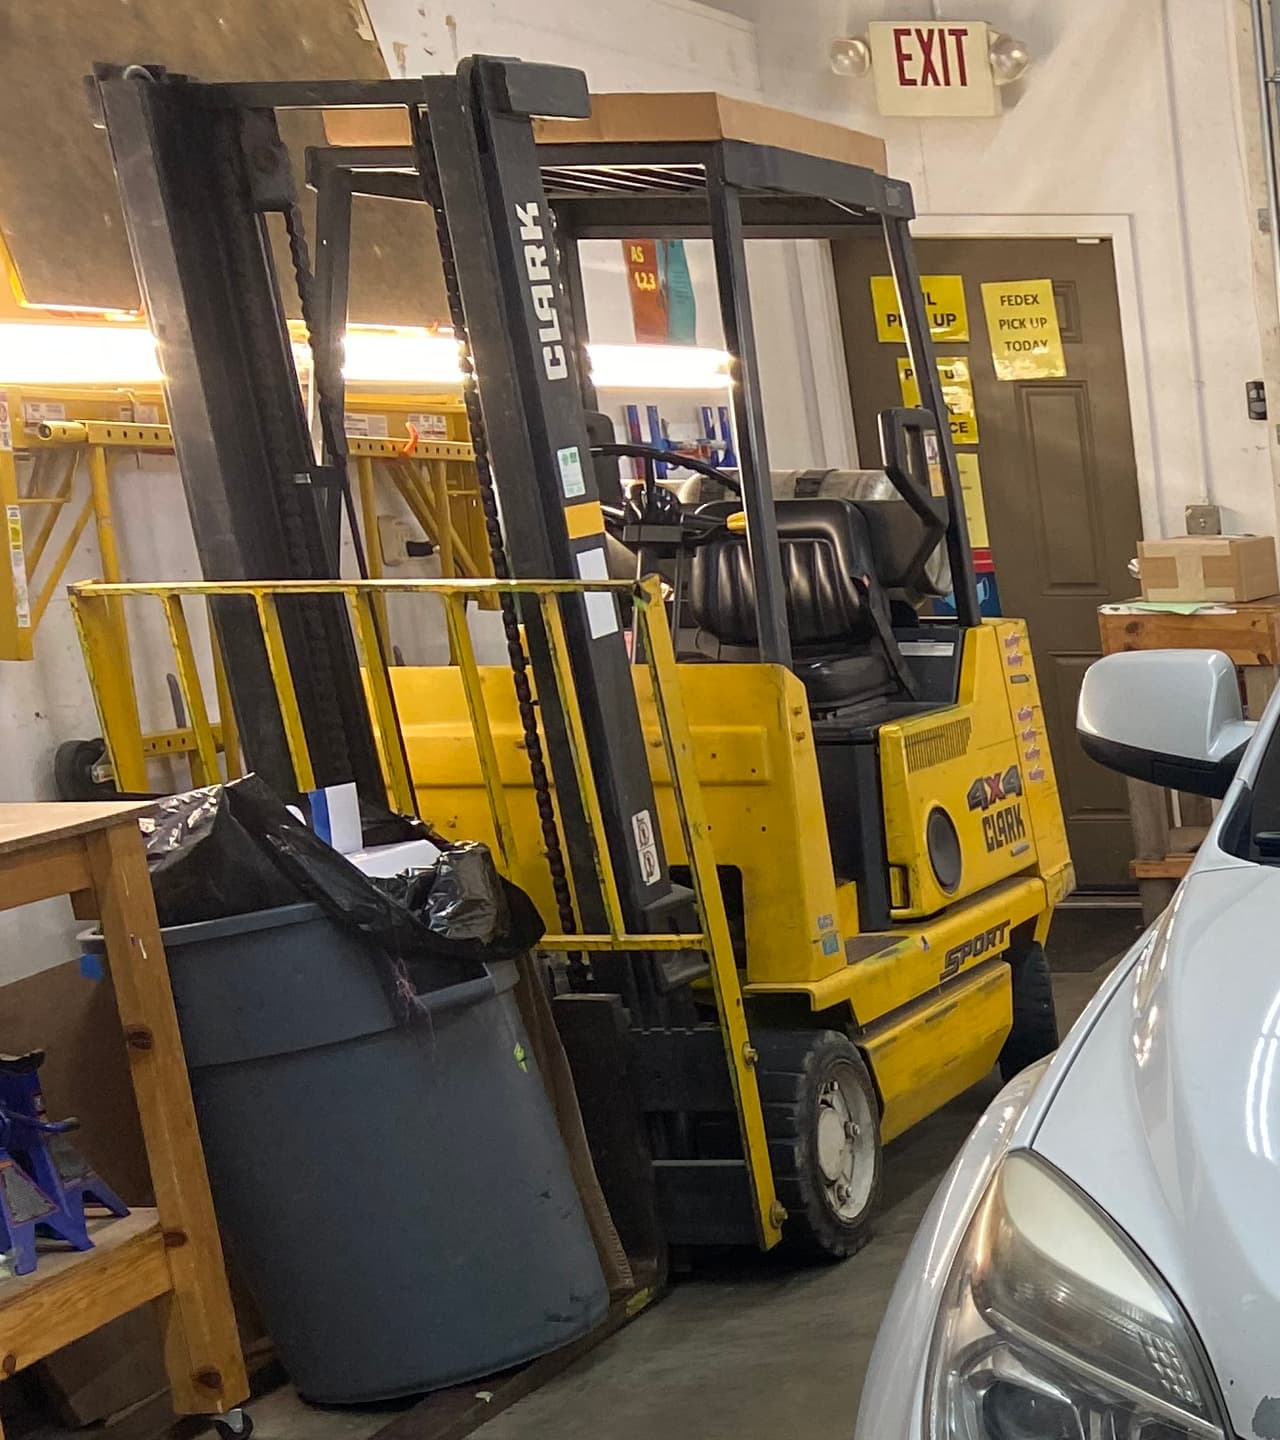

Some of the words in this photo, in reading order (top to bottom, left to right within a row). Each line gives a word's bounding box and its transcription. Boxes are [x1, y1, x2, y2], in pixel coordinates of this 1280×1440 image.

[893, 28, 968, 86] EXIT
[630, 246, 645, 263] AS
[515, 202, 568, 381] CLARK
[1000, 294, 1040, 306] FEDEX
[933, 313, 957, 327] UP
[998, 318, 1027, 331] PICK
[1030, 317, 1048, 329] UP
[1005, 340, 1048, 352] TODAY
[982, 803, 1026, 853] CLARK
[940, 919, 1011, 982] SPORT
